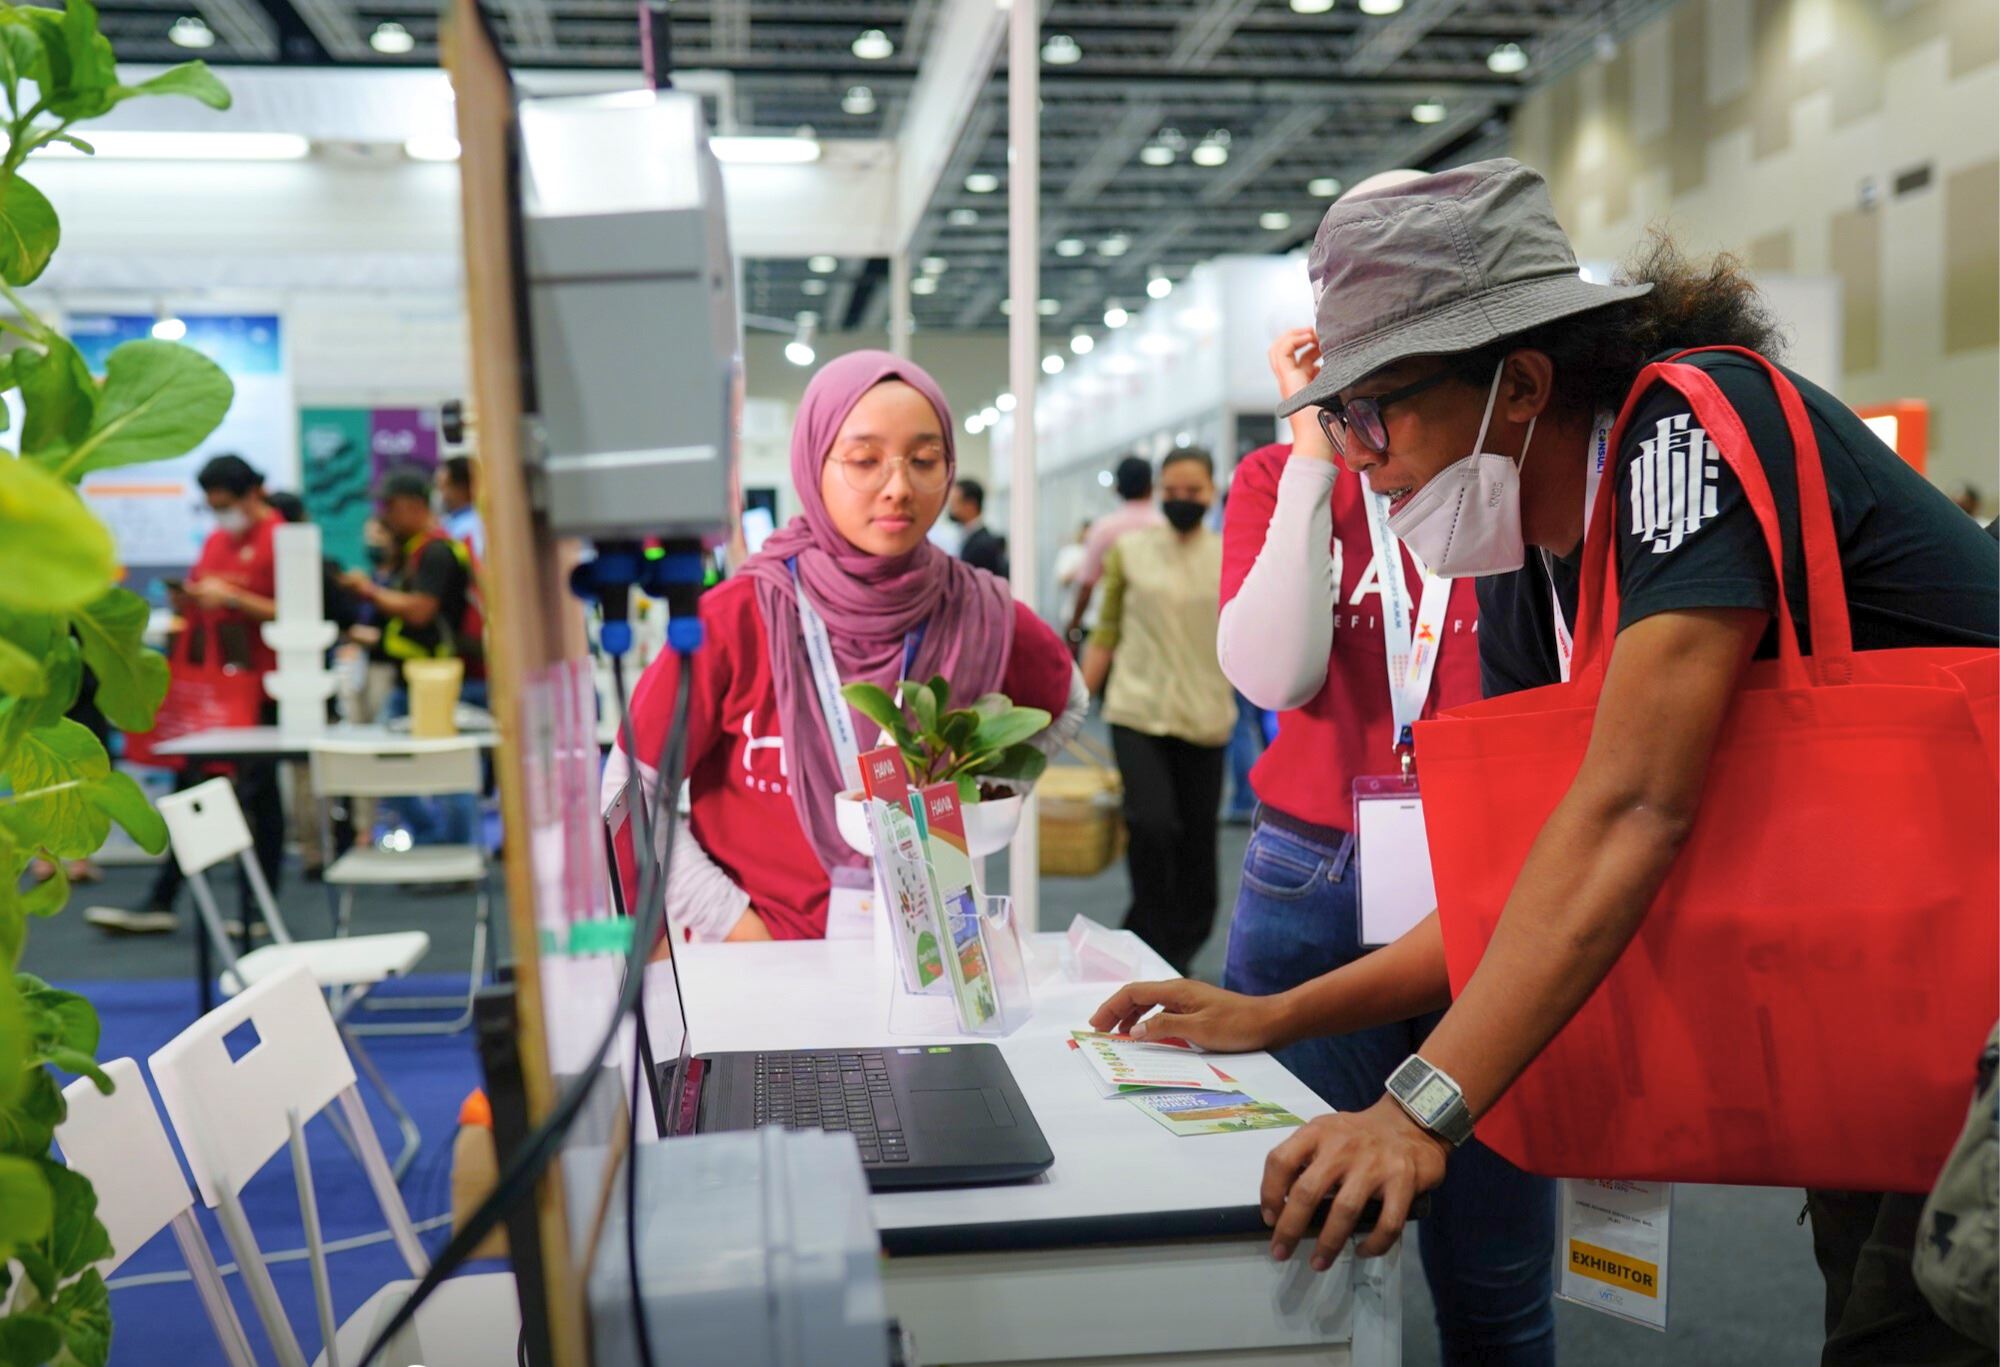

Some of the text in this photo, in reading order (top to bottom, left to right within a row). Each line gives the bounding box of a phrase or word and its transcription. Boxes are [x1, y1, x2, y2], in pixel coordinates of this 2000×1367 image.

[872, 758, 897, 781] HAWA
[929, 795, 954, 817] HAWA
[1571, 1250, 1654, 1288] EXHIBITOR
